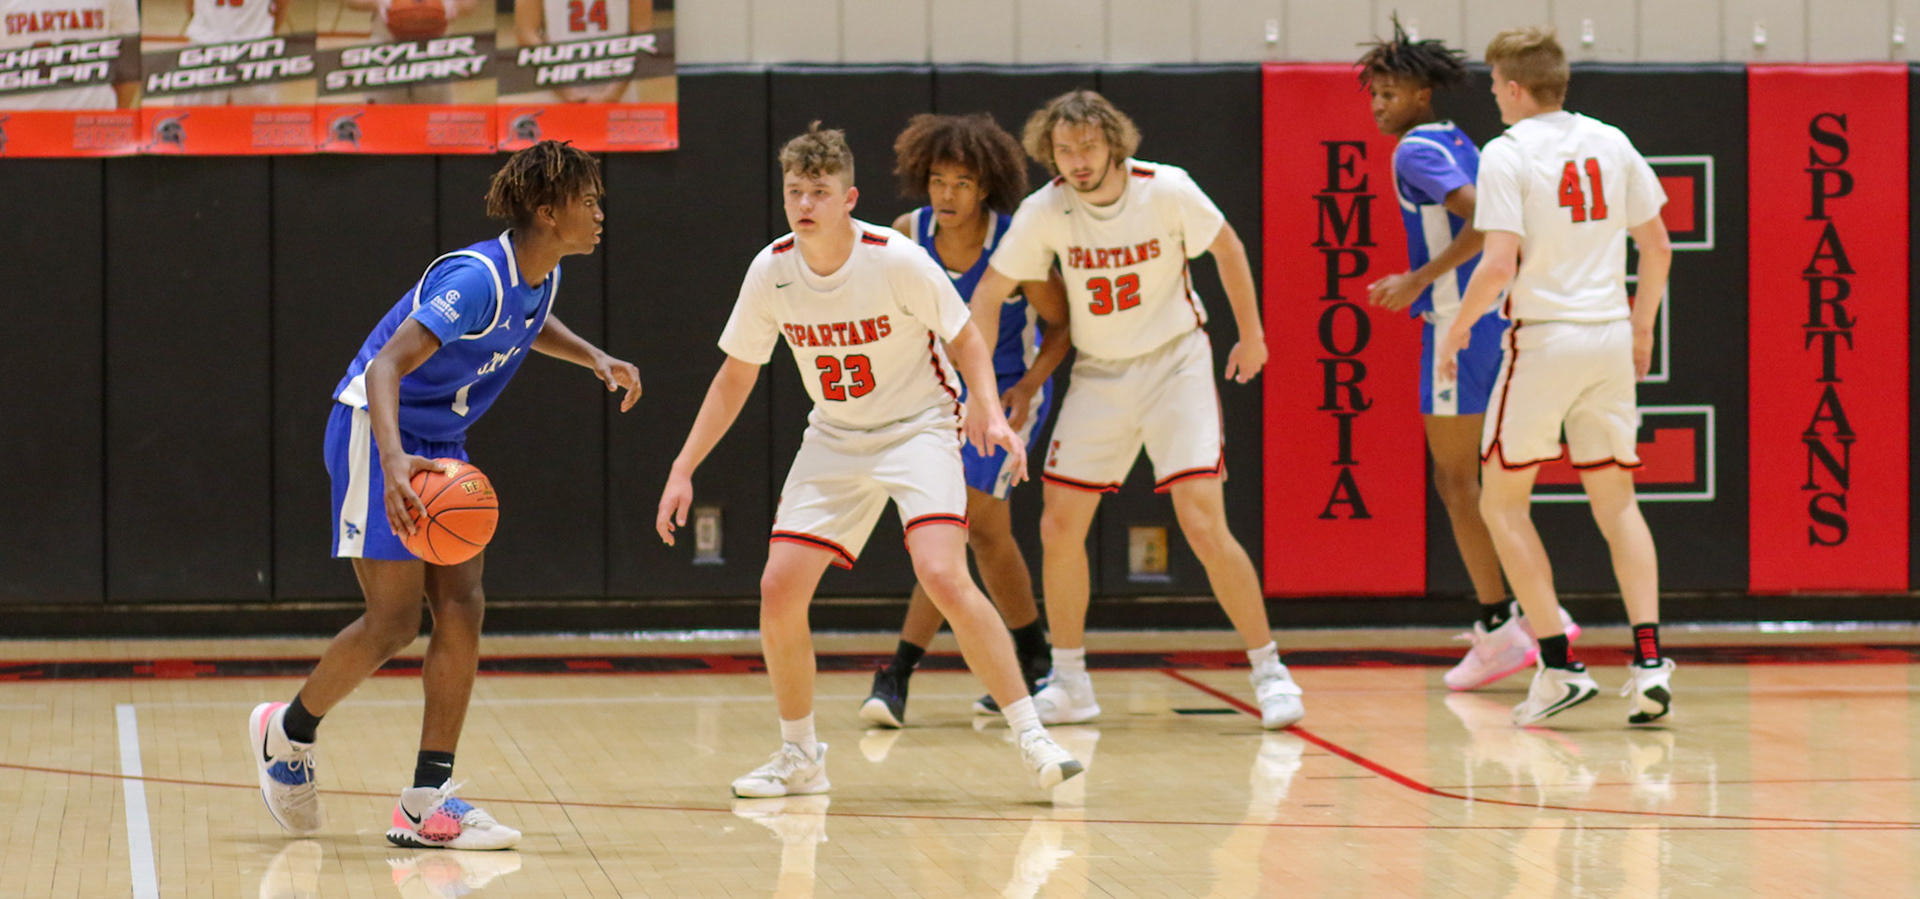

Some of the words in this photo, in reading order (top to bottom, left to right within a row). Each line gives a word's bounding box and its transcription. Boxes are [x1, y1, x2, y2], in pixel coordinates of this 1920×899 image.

[5, 9, 105, 35] SPARTANS
[569, 0, 608, 32] 24
[178, 38, 285, 68] GAVIN
[341, 36, 476, 67] SKYLER
[517, 33, 658, 66] HUNTER
[0, 60, 109, 90] GILPIN
[147, 55, 315, 92] HOELTING
[326, 54, 488, 90] STEWART
[536, 56, 636, 85] HINES
[1558, 158, 1607, 224] 41
[1086, 272, 1142, 316] 32
[783, 315, 892, 347] SPARTANS
[1312, 140, 1377, 519] EMPORIA
[1802, 113, 1856, 547] SPARTANS
[815, 354, 876, 401] 23
[451, 382, 475, 417] 1
